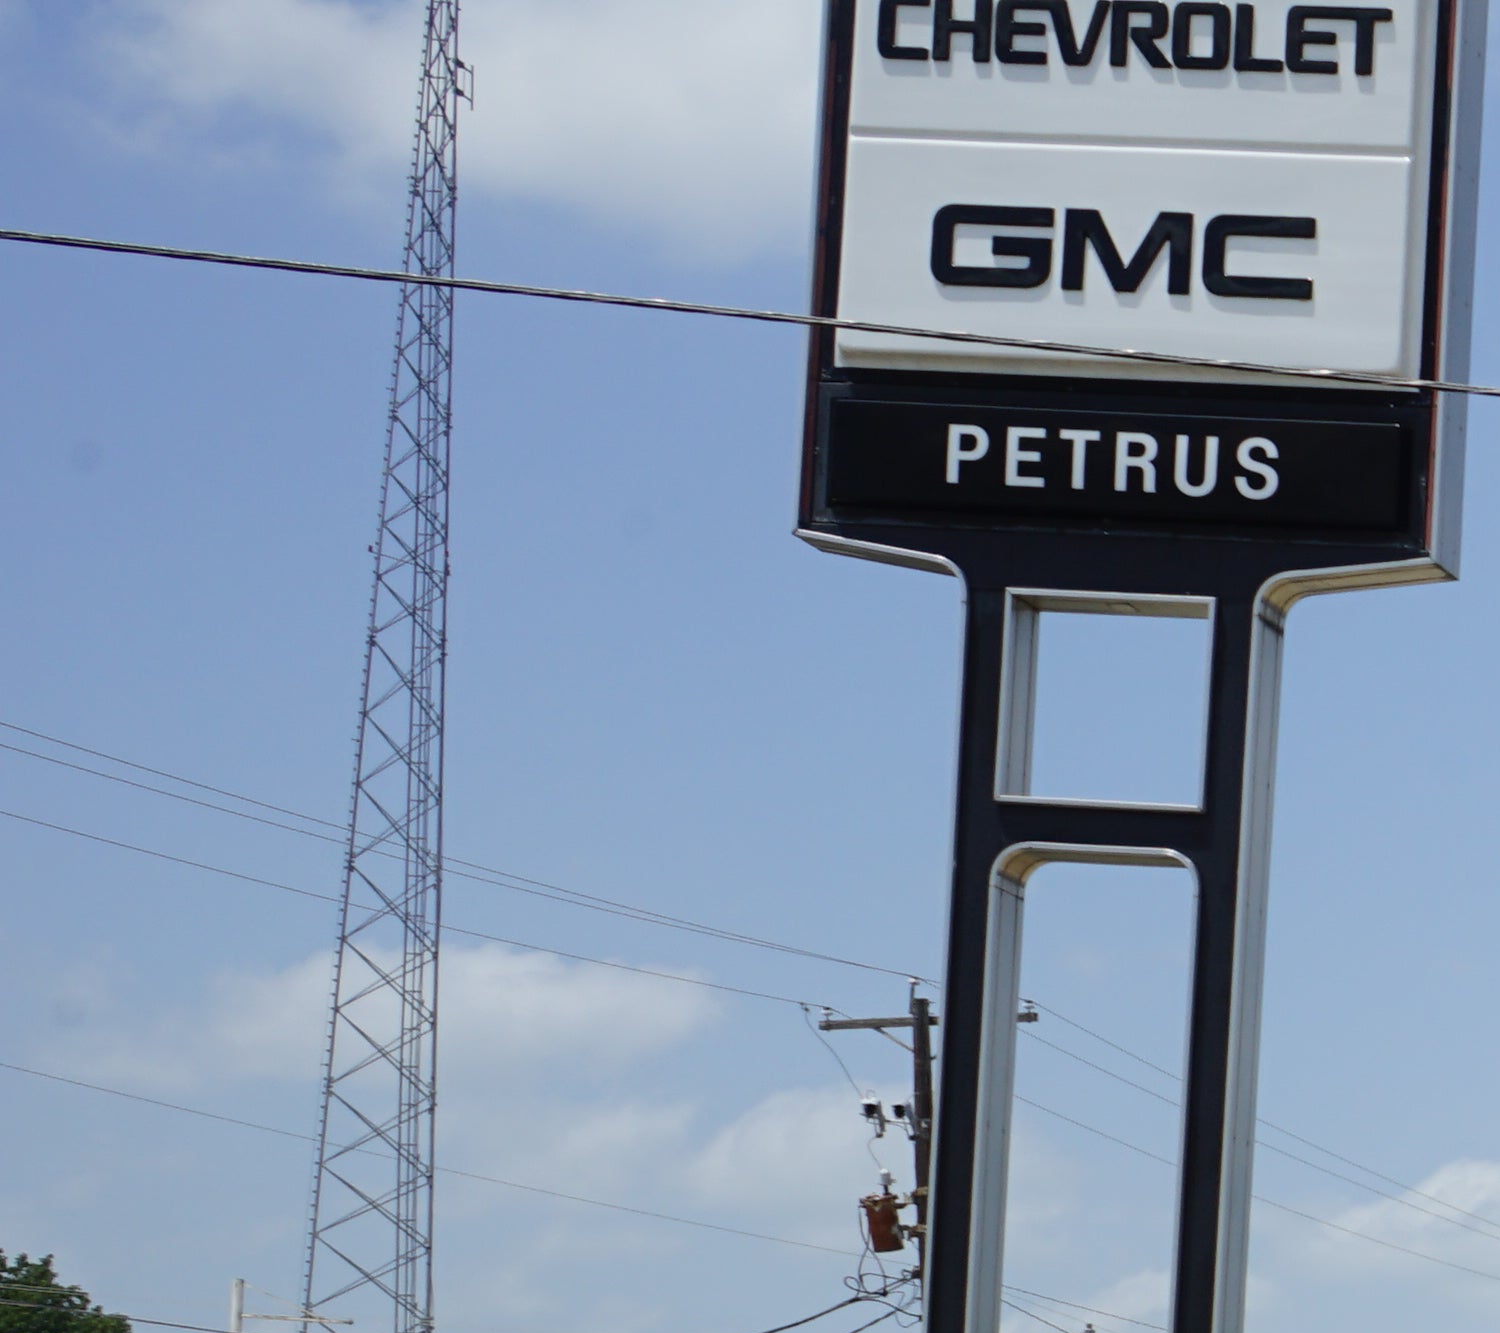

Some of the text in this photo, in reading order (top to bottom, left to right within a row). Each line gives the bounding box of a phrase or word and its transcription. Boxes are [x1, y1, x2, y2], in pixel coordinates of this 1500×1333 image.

[877, 0, 1392, 76] CHEVROLET
[930, 203, 1317, 300] GMC
[946, 423, 1280, 500] PETRUS
